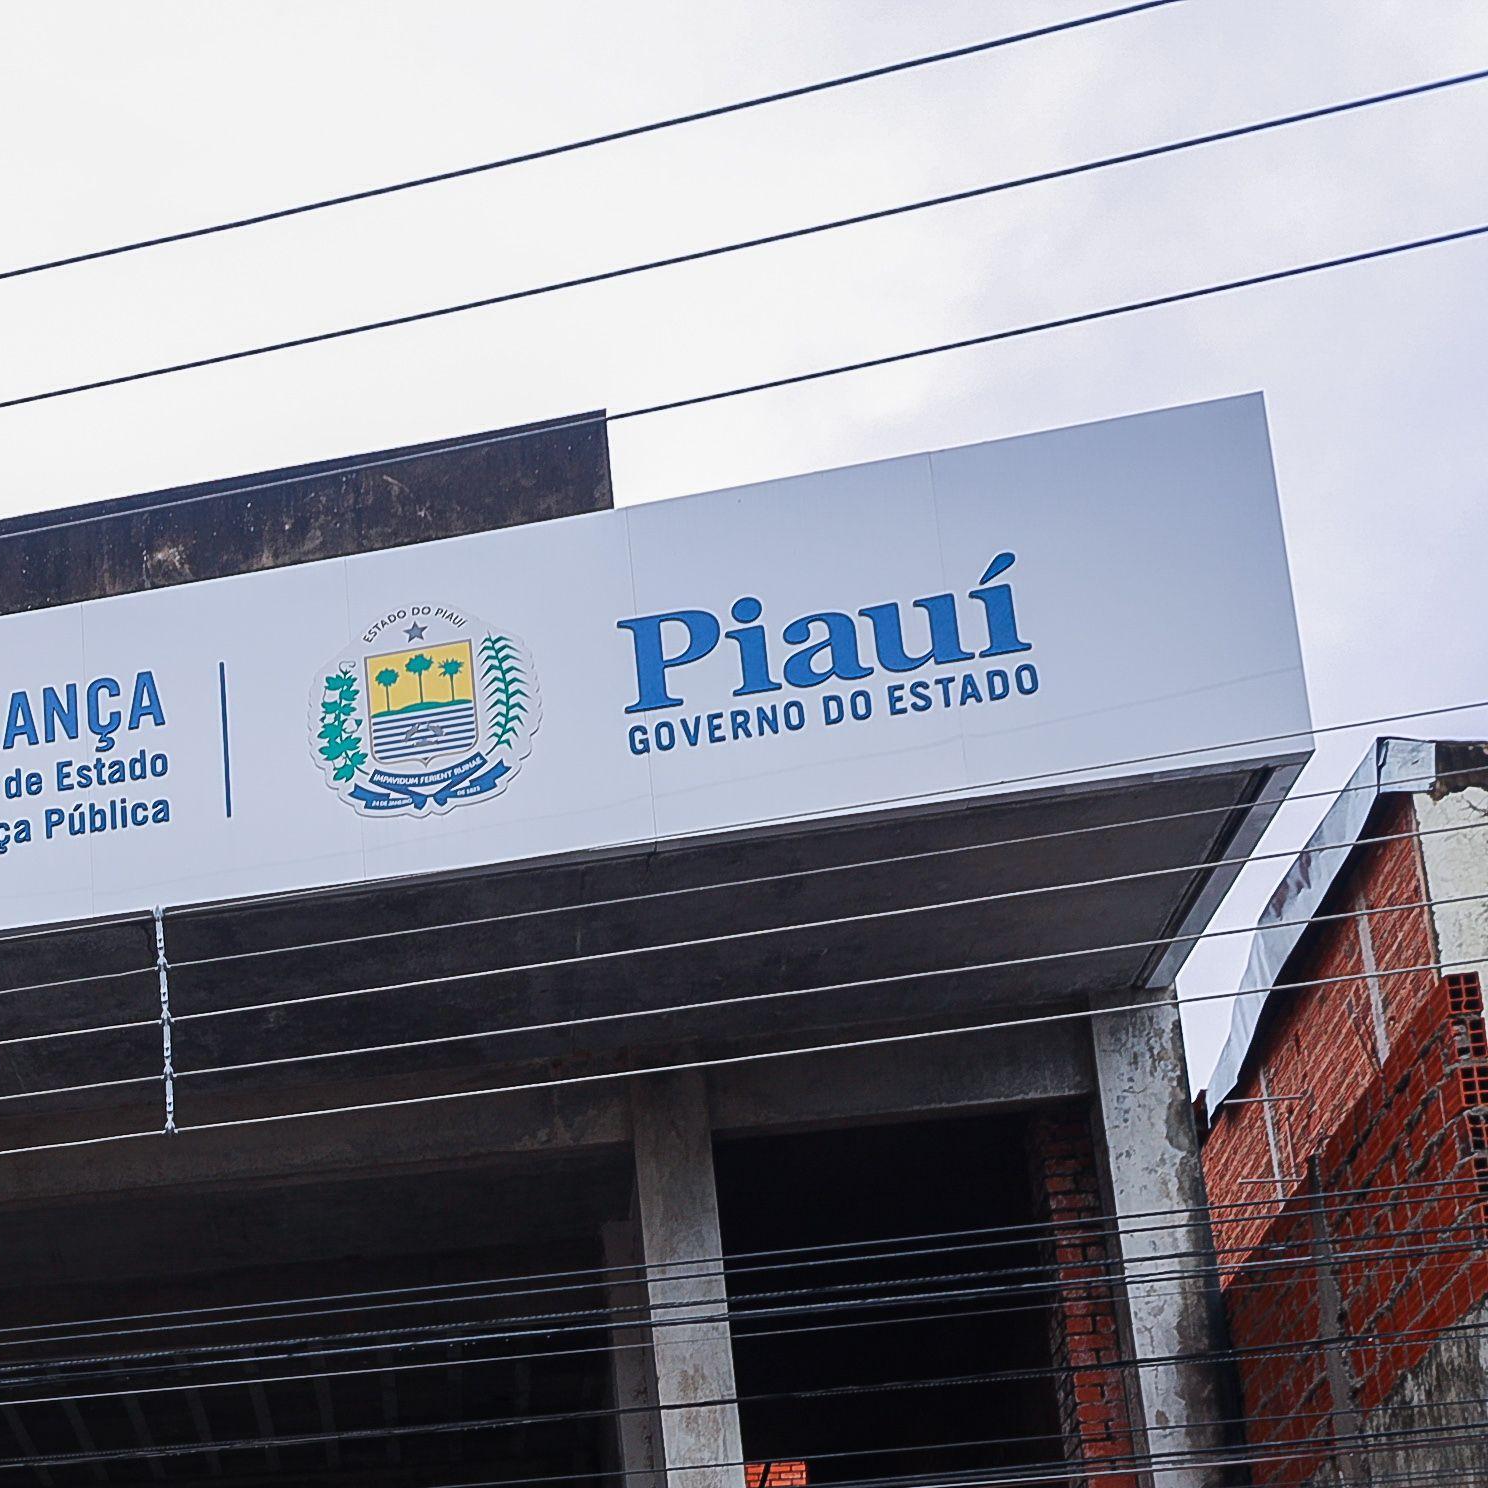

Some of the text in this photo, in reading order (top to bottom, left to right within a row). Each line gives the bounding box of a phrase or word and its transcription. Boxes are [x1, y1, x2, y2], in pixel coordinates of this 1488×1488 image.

[362, 606, 469, 644] ESTADO DO PIAUÍ
[616, 551, 1033, 714] Piauí
[628, 663, 1040, 755] GOVERNO DO ESTADO
[3, 768, 43, 800] de
[56, 749, 169, 792] Estado
[44, 797, 171, 840] Pública
